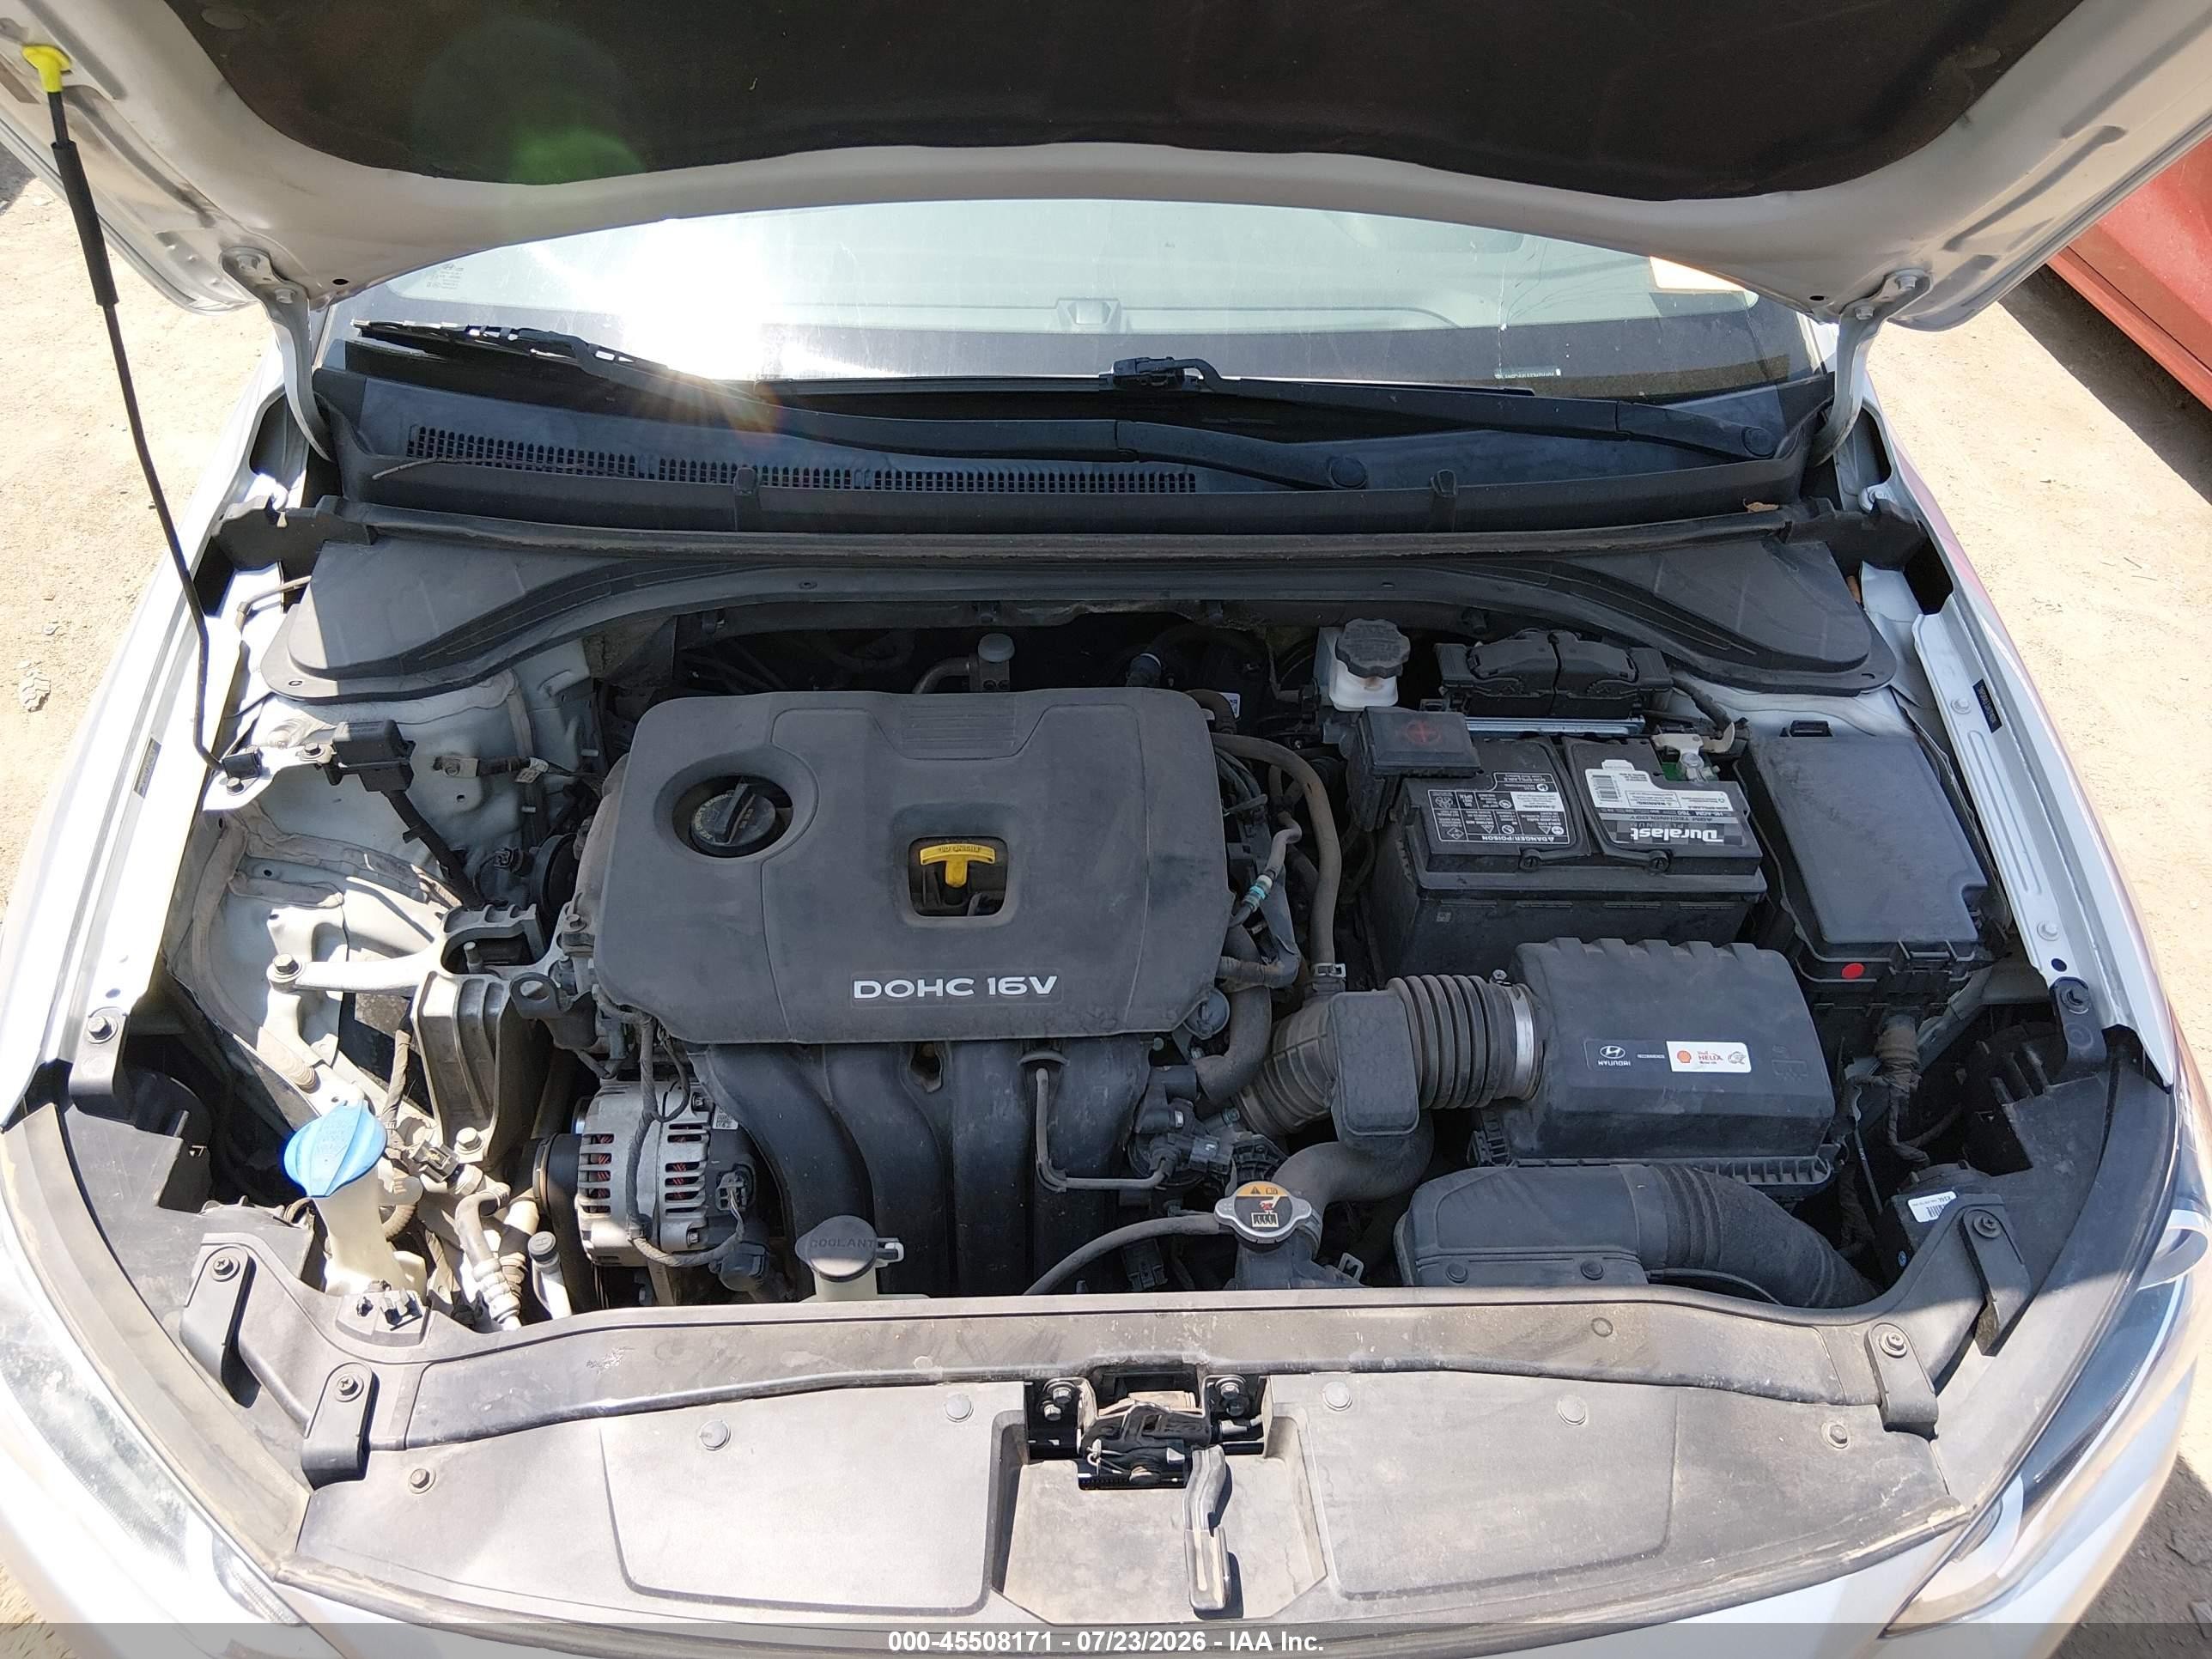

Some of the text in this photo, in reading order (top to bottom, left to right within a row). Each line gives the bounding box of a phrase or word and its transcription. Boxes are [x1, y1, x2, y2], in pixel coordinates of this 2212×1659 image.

[1631, 828, 1724, 842] Duralast
[854, 975, 1058, 999] DOHC 16V
[810, 1237, 876, 1249] COOLANT
